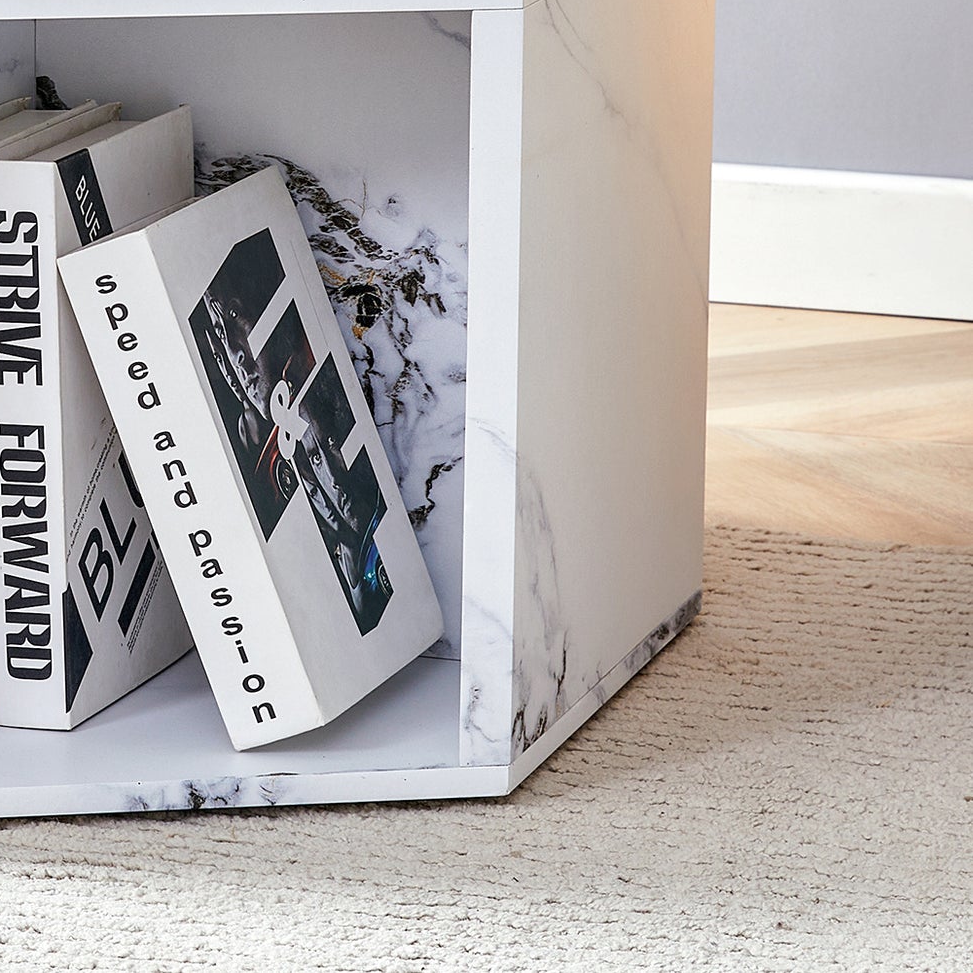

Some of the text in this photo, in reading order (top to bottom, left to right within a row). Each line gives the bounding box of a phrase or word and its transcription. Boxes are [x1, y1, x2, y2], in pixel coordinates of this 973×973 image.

[95, 274, 277, 724] speed and passion
